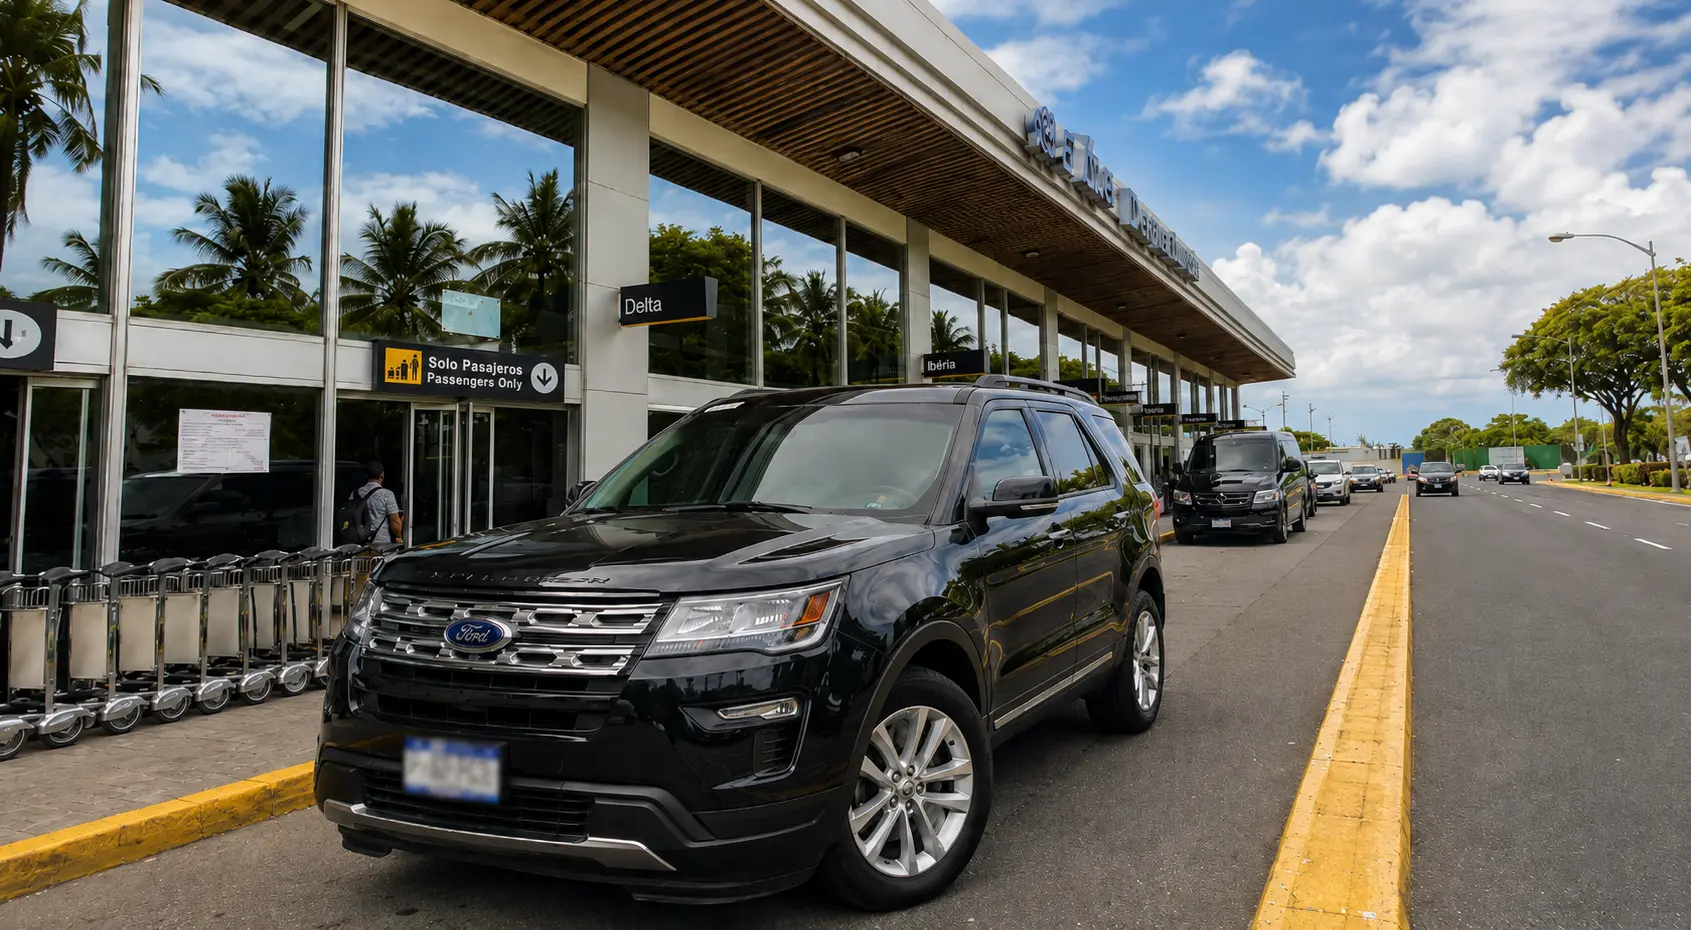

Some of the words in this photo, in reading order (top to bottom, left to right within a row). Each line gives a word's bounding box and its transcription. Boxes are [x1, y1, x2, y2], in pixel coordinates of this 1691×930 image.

[625, 297, 662, 315] Delta
[428, 356, 458, 370] Solo
[462, 358, 523, 376] Pasajeros
[427, 372, 494, 389] Passengers
[498, 377, 523, 391] Only
[455, 623, 491, 643] Ford
